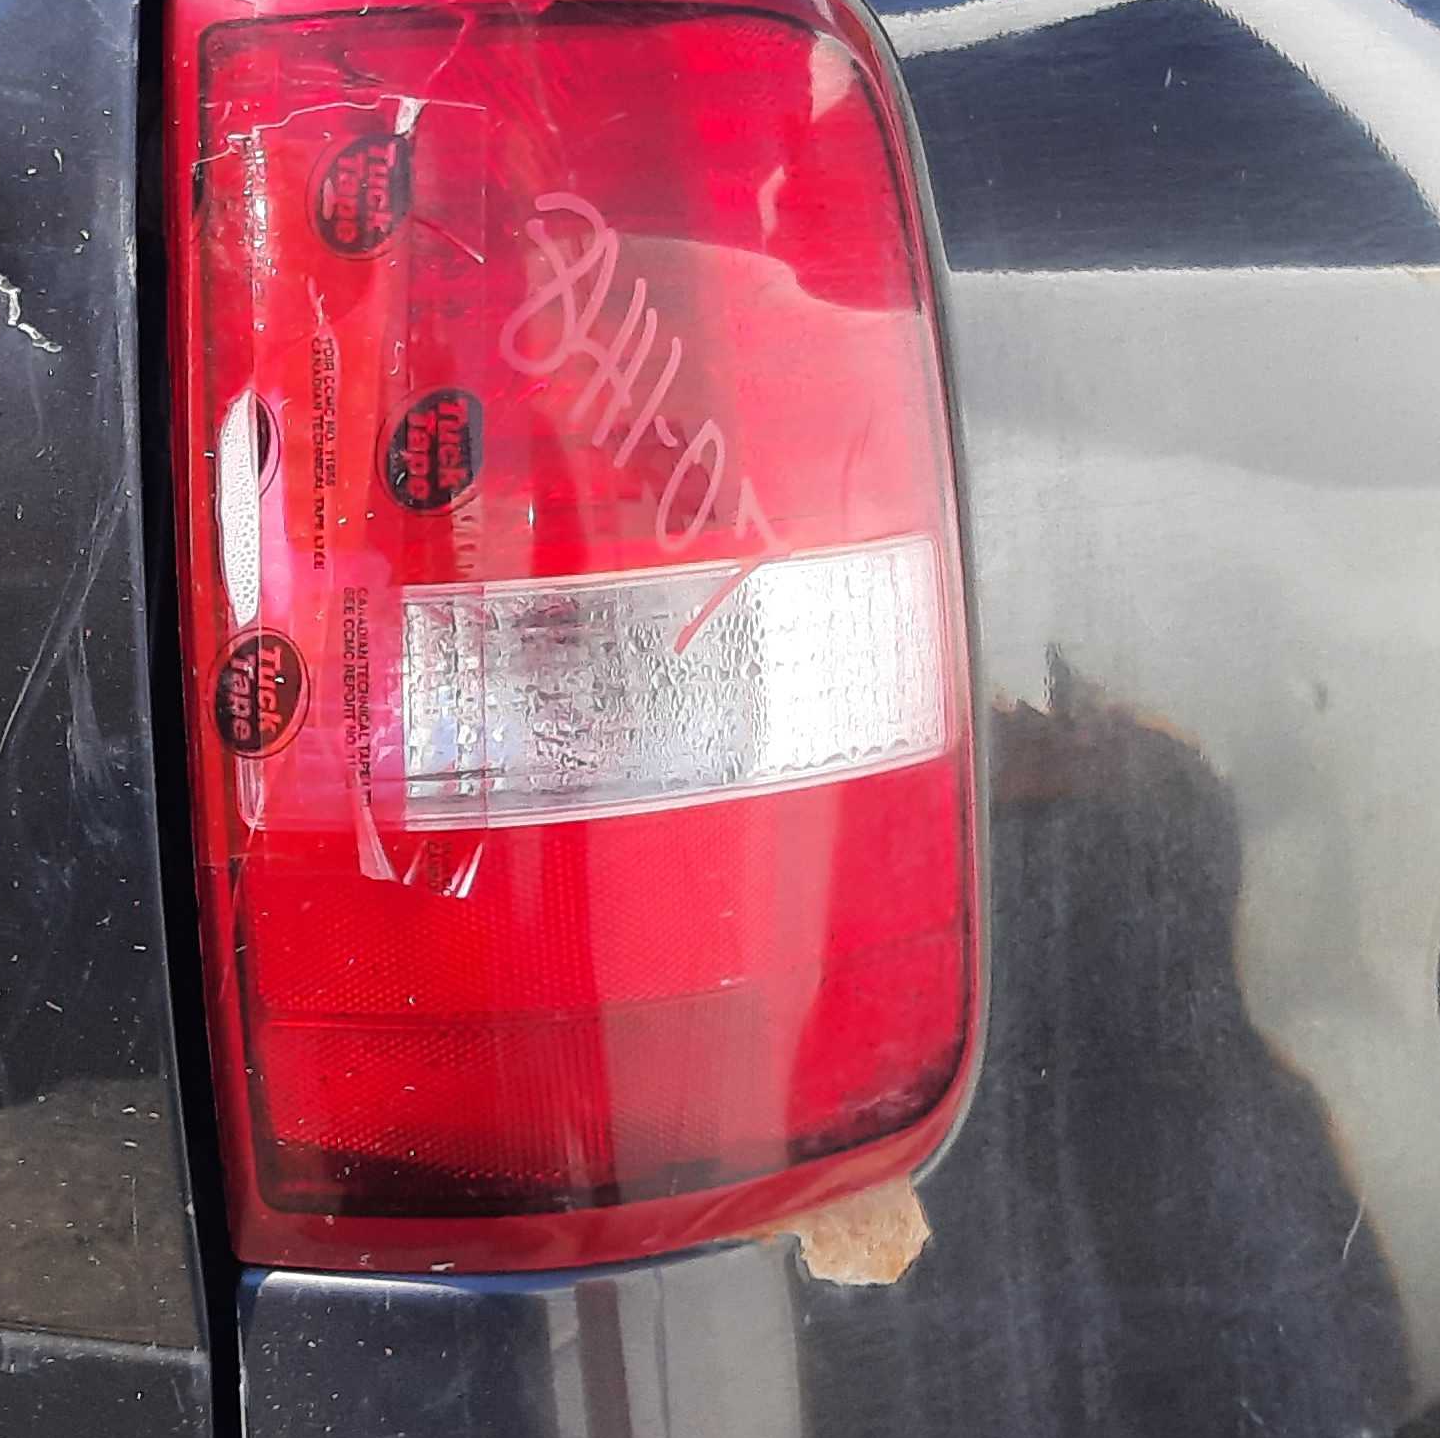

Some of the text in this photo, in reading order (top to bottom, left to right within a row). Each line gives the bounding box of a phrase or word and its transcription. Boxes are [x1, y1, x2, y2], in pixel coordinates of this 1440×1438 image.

[405, 410, 437, 501] Tape
[436, 396, 471, 491] Tuck
[230, 655, 258, 743] Tape
[258, 644, 285, 736] Tuck
